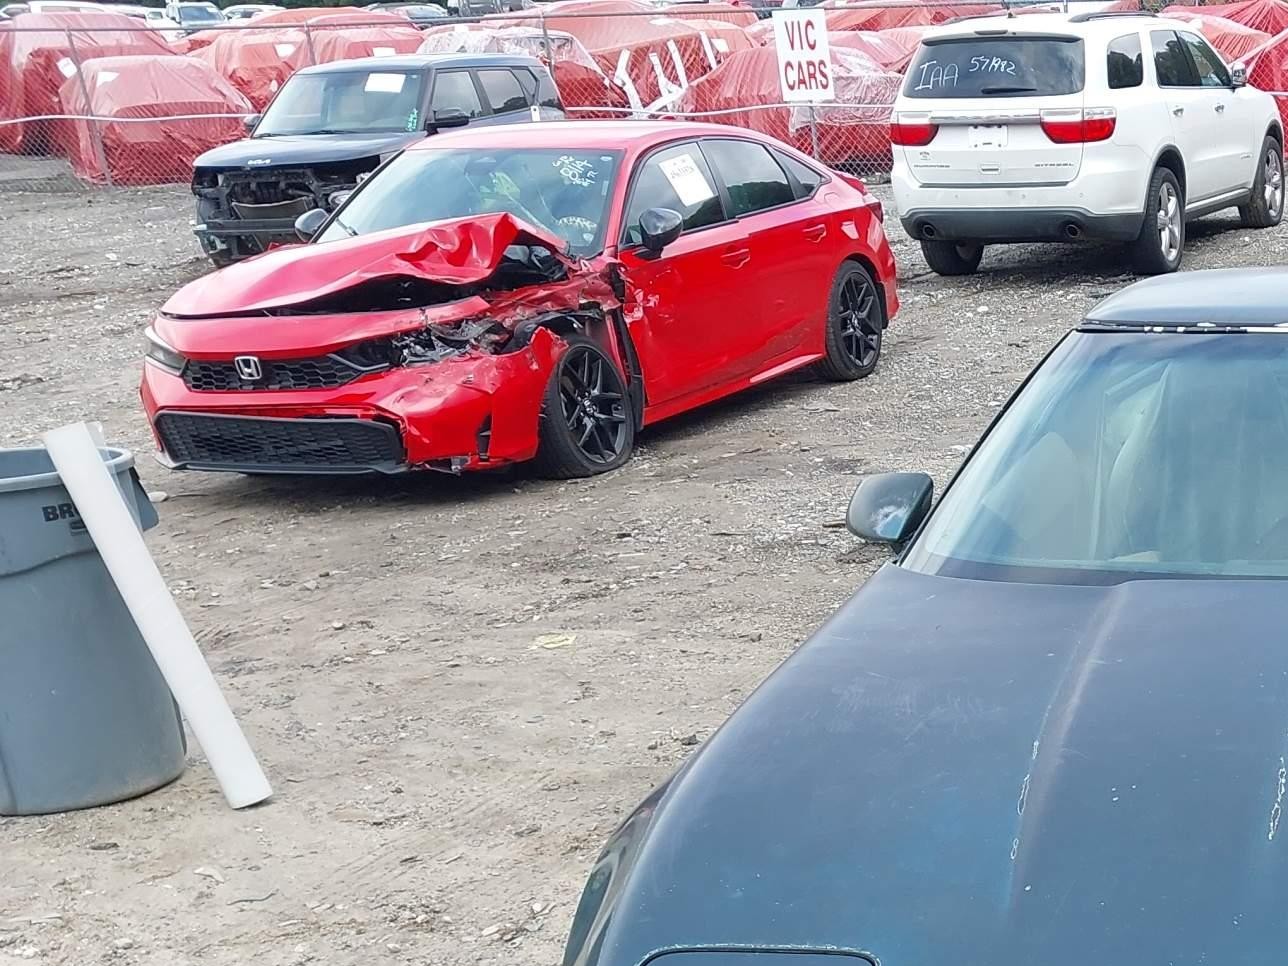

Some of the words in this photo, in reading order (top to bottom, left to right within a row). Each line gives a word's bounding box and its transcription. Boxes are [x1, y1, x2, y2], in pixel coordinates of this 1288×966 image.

[784, 20, 817, 51] VIC
[784, 59, 829, 91] CARS
[914, 60, 959, 91] IAA
